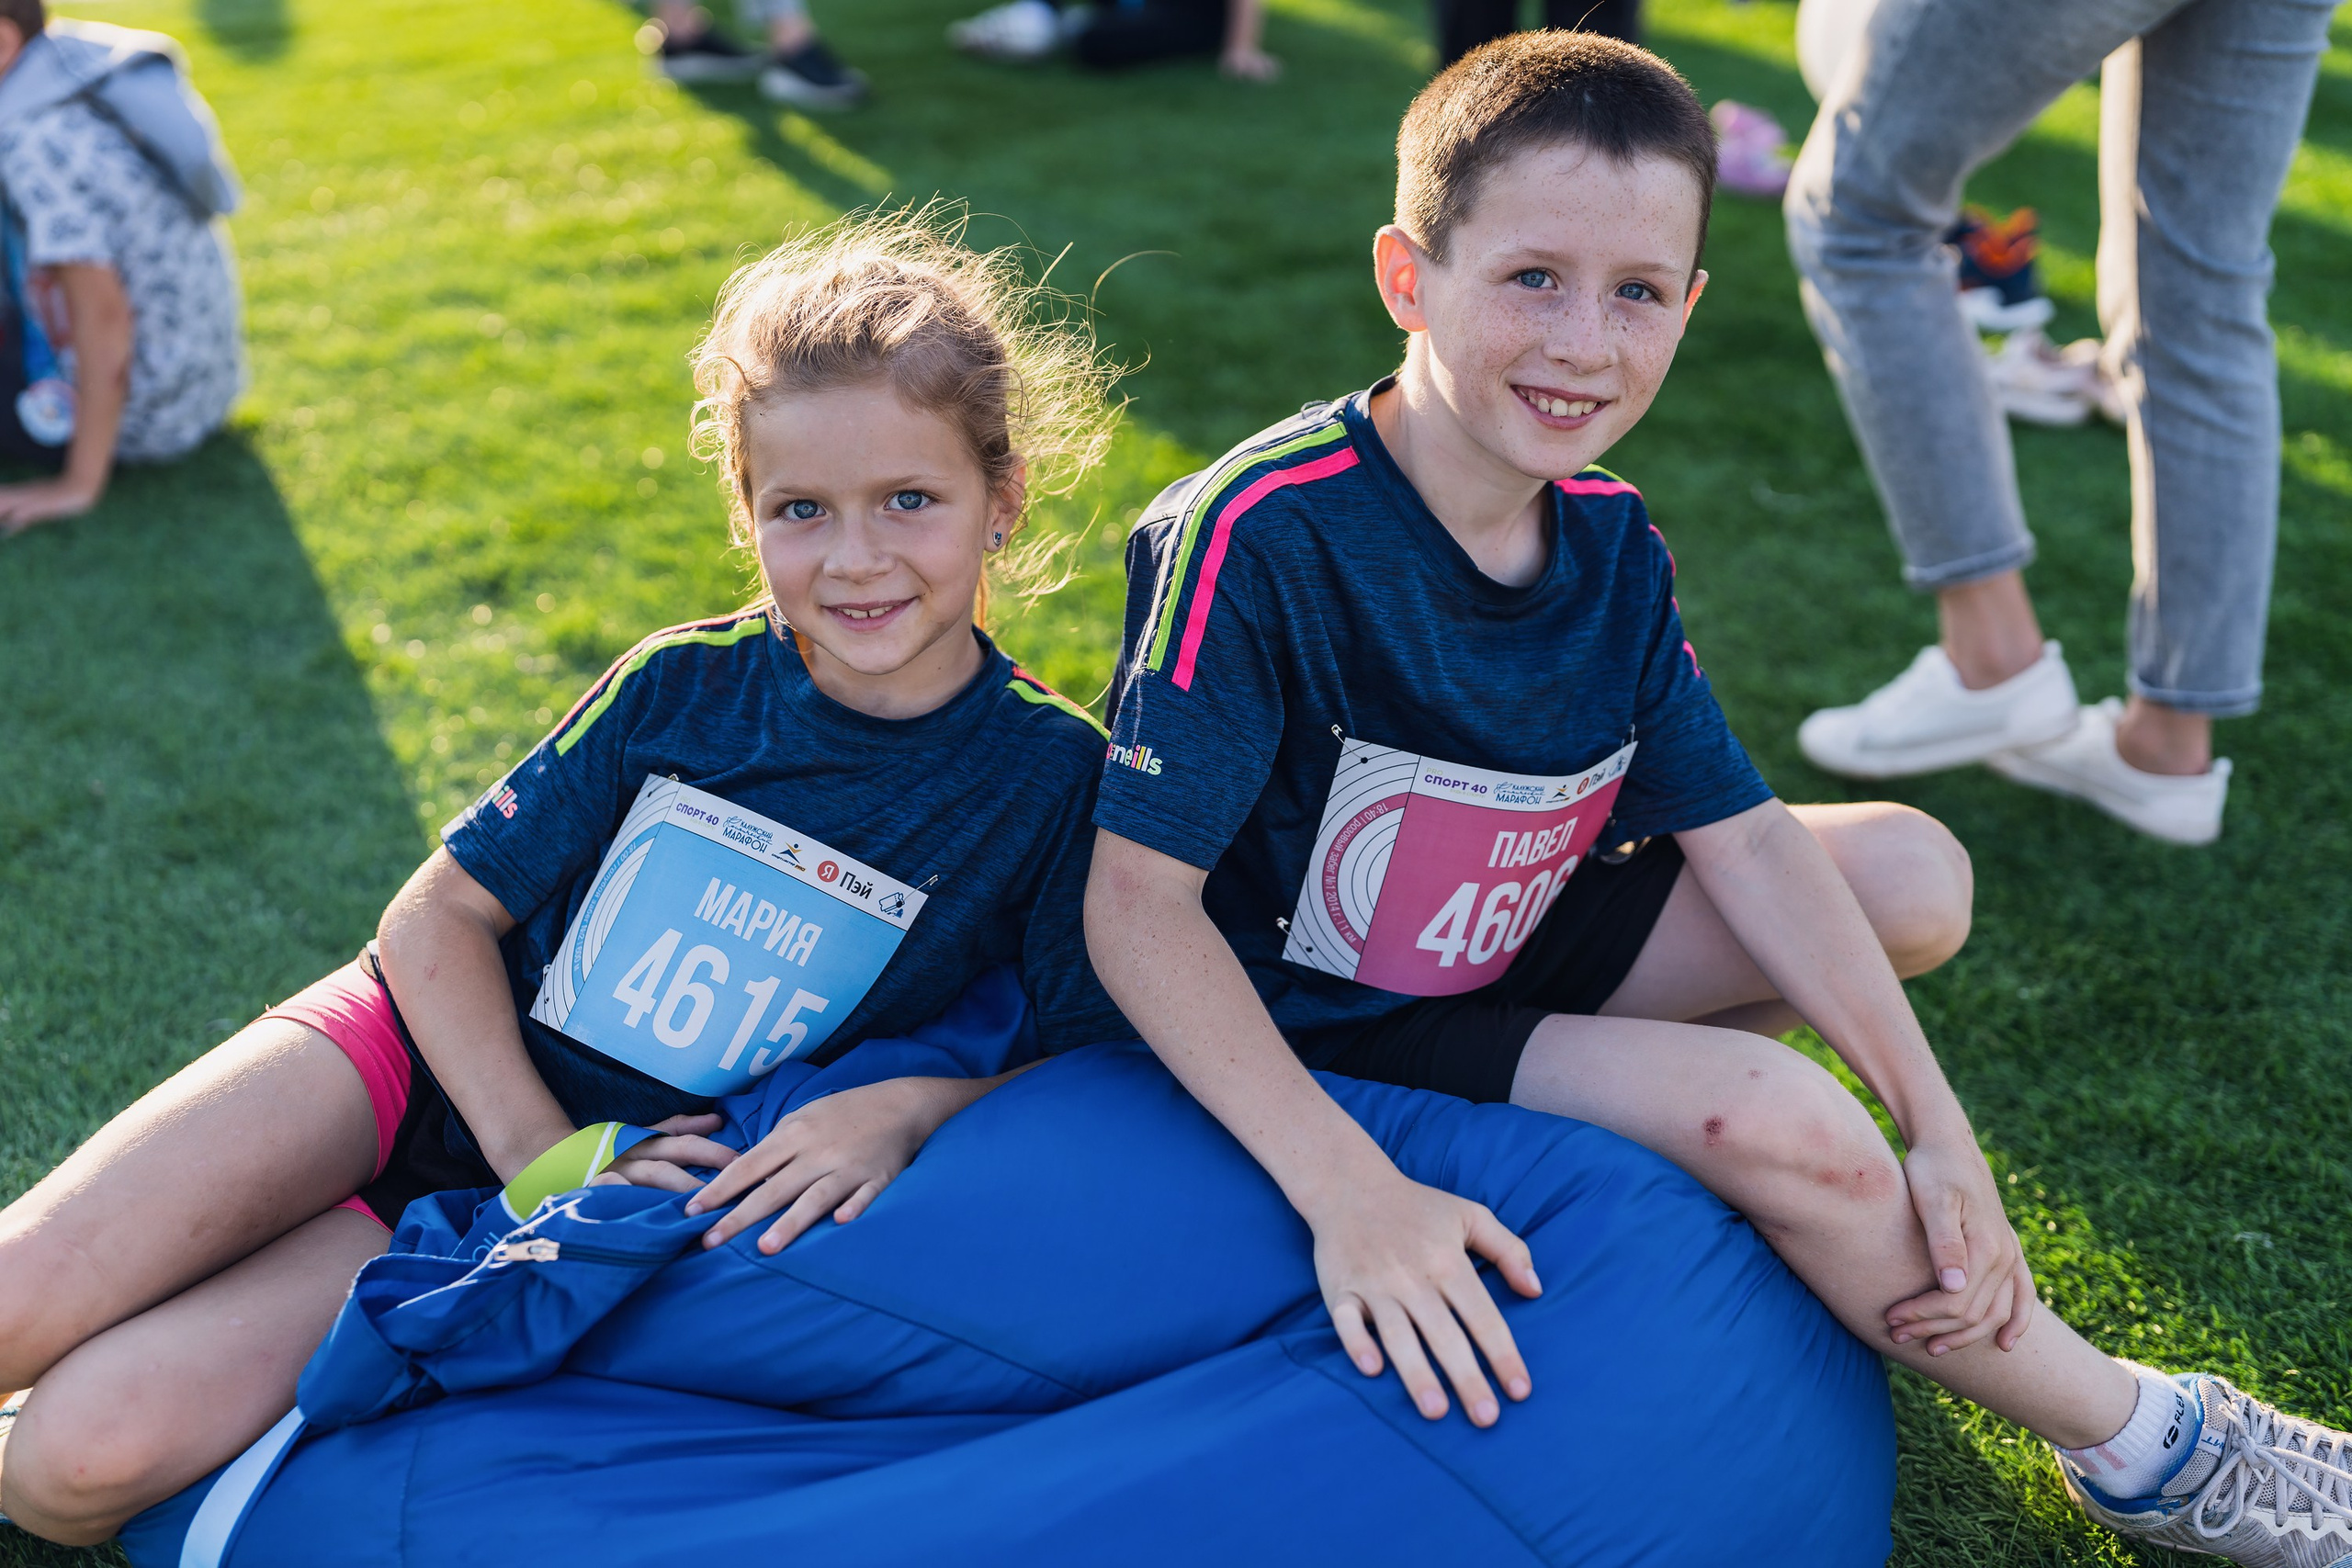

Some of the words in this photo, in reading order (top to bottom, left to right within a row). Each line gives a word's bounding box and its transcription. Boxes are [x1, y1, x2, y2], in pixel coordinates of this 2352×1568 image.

[1424, 774, 1470, 791] СПОРТ
[1471, 784, 1487, 795] 40
[1363, 802, 1389, 821] 18:40
[1495, 793, 1542, 805] МАРАФОН
[675, 802, 707, 821] СПОРТ
[706, 814, 719, 826] 40
[722, 827, 768, 854] МАРАФОН
[740, 820, 774, 840] КАЛУЖСКИЙ
[1333, 818, 1362, 852] розовый
[1487, 816, 1578, 868] ПАВЕЛ
[1326, 852, 1340, 874] забег
[594, 863, 617, 898] голубой
[820, 863, 836, 880] Я
[839, 871, 874, 900] Пэй
[1325, 874, 1336, 889] №1
[583, 898, 596, 924] забег
[1326, 890, 1340, 912] 2014
[1415, 854, 1579, 968] 4606
[694, 876, 824, 968] МАРИЯ
[1344, 930, 1357, 944] км
[612, 927, 830, 1077] 4615
[2174, 1392, 2186, 1425] FLEX
